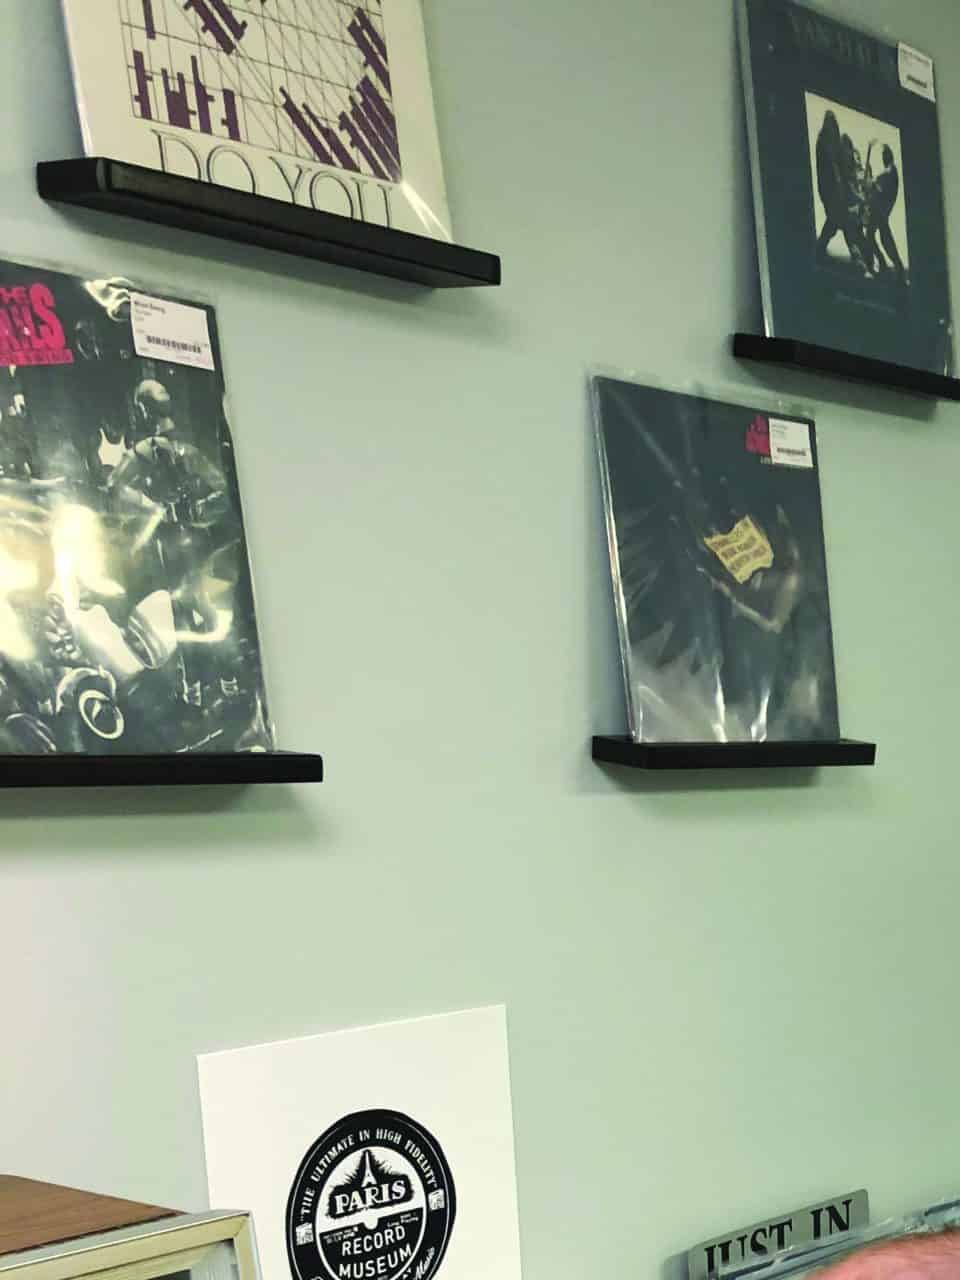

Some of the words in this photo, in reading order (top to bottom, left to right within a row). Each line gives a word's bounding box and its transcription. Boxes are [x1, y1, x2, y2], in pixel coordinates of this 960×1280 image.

[310, 1133, 356, 1183] ULTIMATE
[358, 1129, 371, 1142] IN
[375, 1127, 402, 1145] HIGH
[334, 1179, 407, 1216] PARIS
[810, 1199, 853, 1241] IN
[341, 1224, 406, 1257] RECORD
[339, 1242, 412, 1280] MUSEUM
